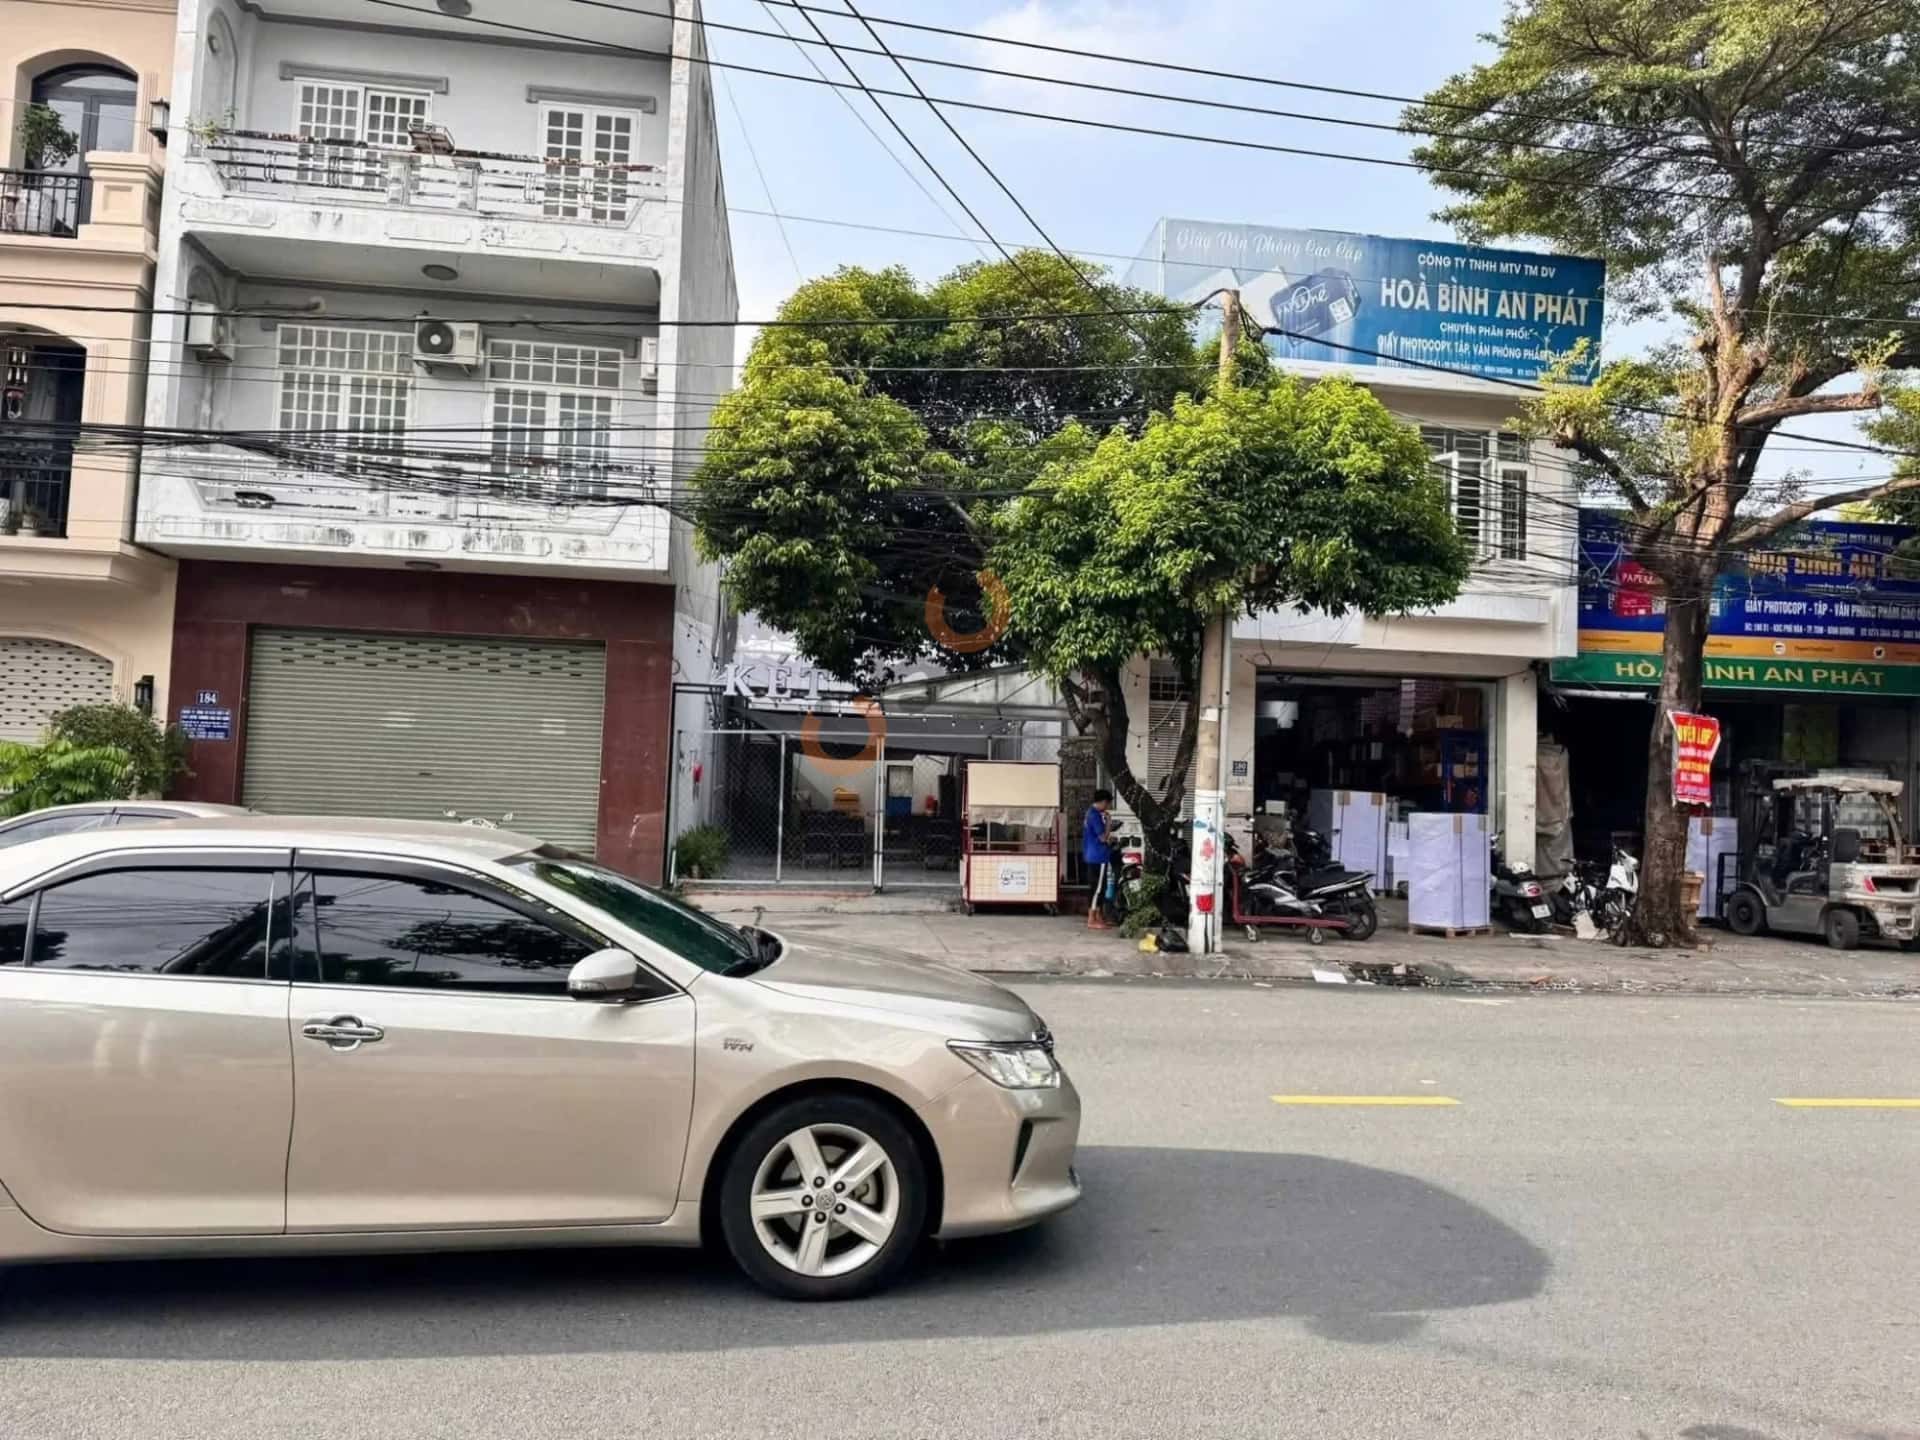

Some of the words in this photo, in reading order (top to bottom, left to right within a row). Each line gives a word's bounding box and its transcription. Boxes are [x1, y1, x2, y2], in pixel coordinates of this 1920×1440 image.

[1418, 252, 1450, 266] CÔNG
[1454, 257, 1467, 267] TY
[1469, 259, 1498, 272] TNHH
[1500, 263, 1522, 275] MTV
[1524, 264, 1538, 276] TM
[1380, 272, 1430, 311] HOÀ
[1437, 276, 1489, 317] BÌNH
[1496, 289, 1527, 320] AN
[1534, 288, 1589, 327] PHÁT
[1764, 600, 1807, 615] PHOTOCOPY
[1616, 659, 1663, 678] HÒ
[1704, 662, 1755, 681] ÌNH
[1764, 668, 1804, 682] AN
[1812, 667, 1885, 686] PHÁT
[199, 692, 217, 704] 184
